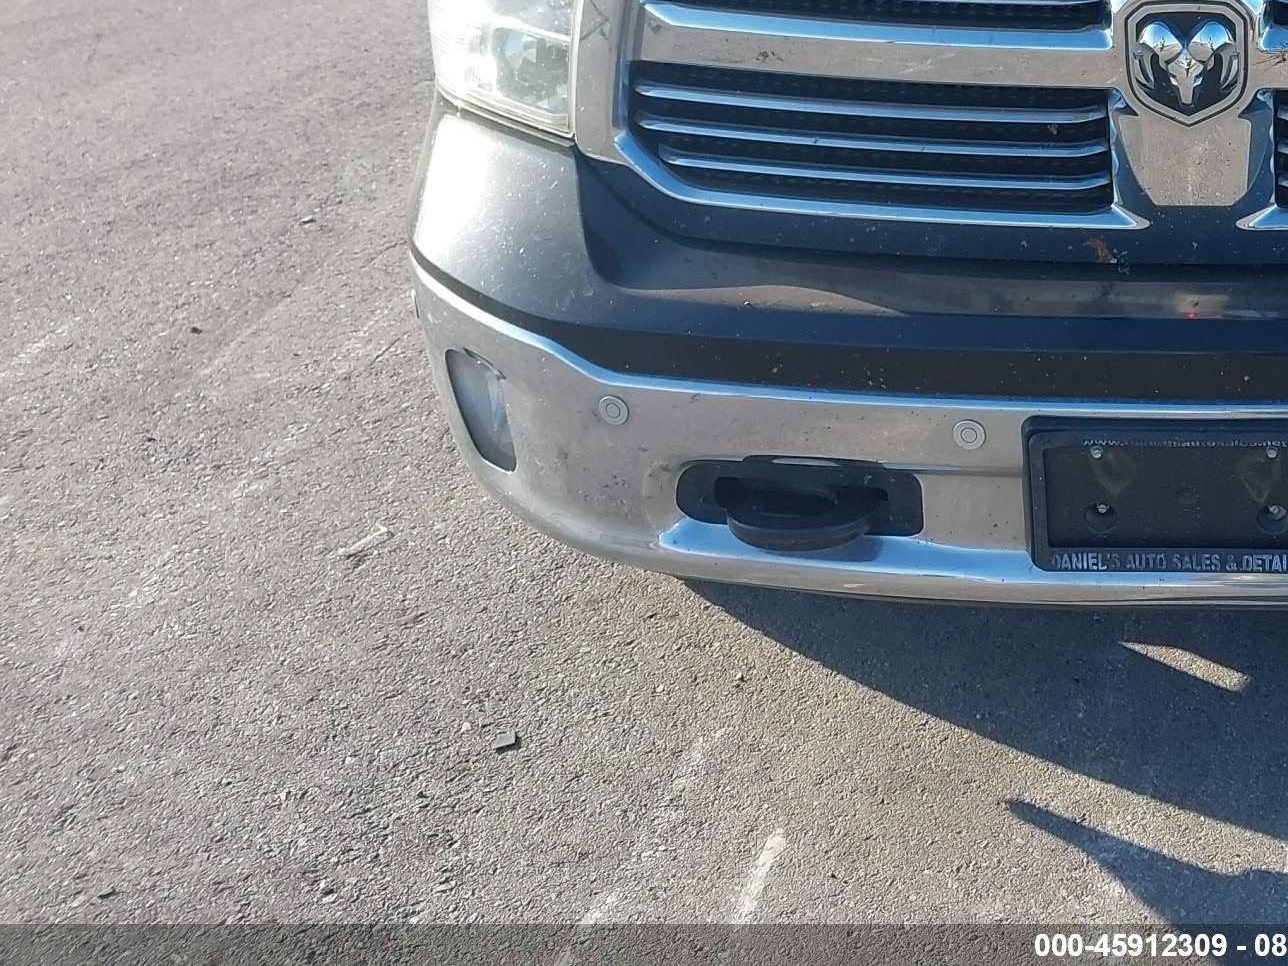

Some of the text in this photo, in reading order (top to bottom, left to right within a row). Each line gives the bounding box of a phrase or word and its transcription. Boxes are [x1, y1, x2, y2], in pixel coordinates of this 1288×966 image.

[1126, 553, 1167, 571] AUTO
[1172, 553, 1221, 572] SALES
[1225, 555, 1238, 572] &
